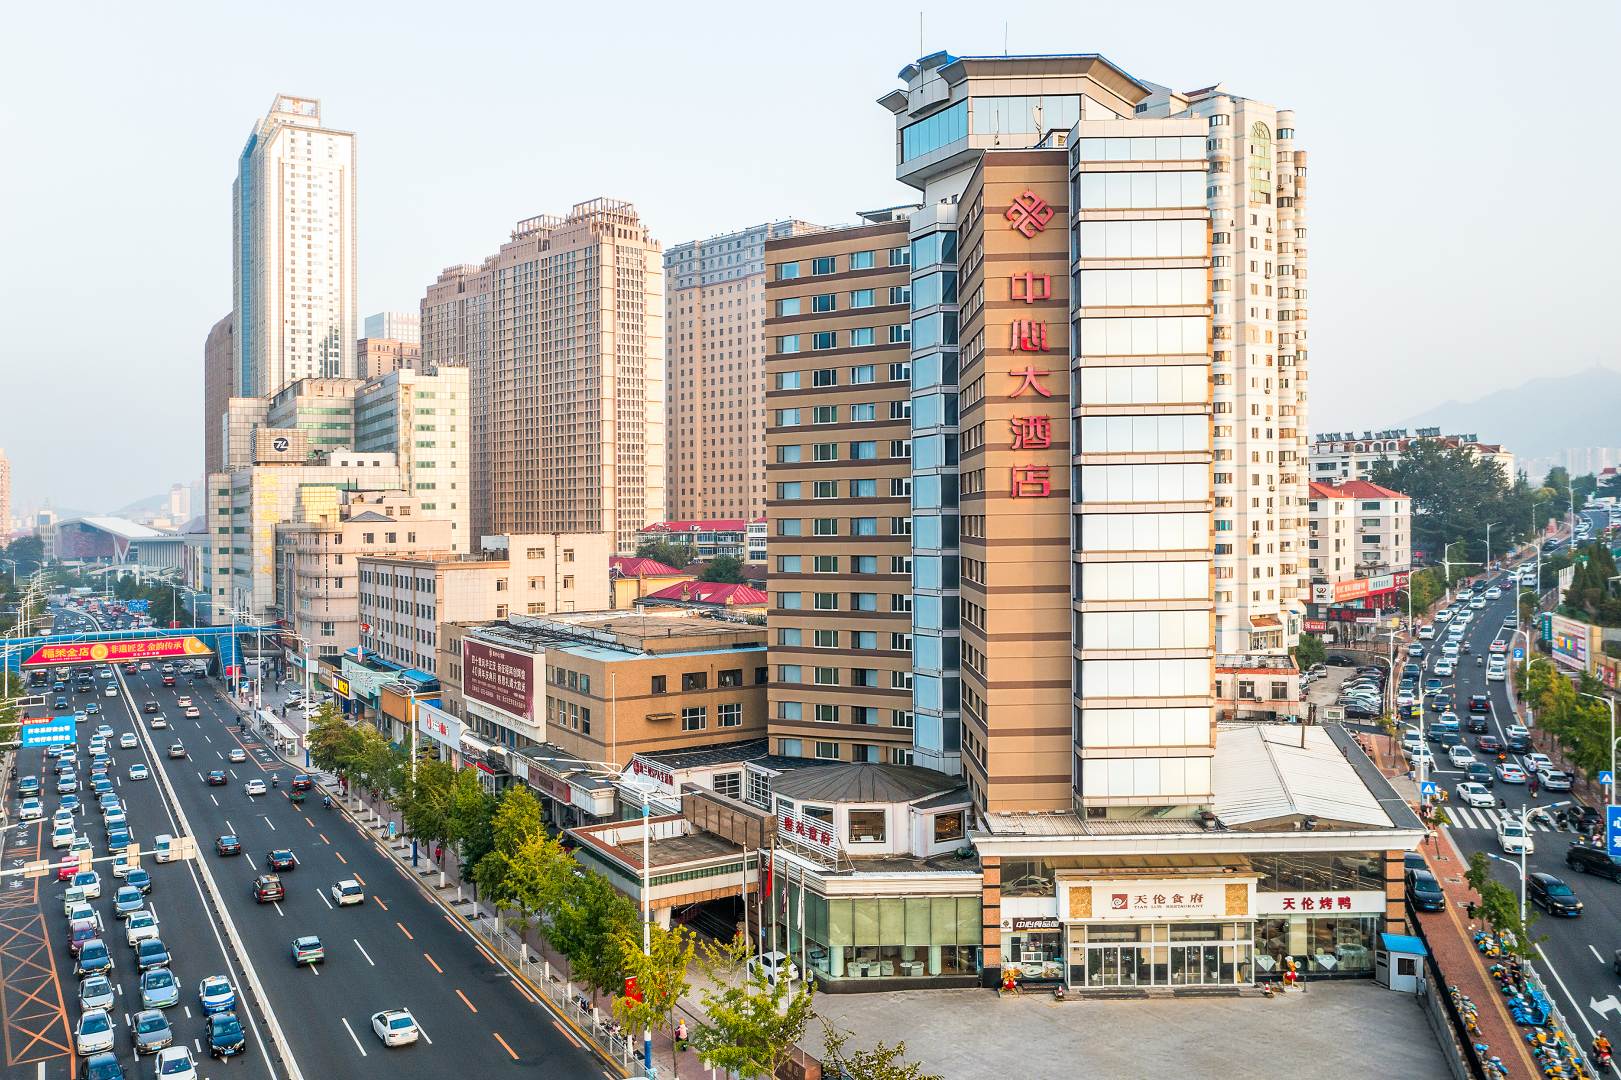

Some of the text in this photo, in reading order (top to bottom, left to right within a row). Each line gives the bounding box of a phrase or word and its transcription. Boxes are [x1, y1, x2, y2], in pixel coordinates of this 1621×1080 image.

[1009, 270, 1053, 500] 中心大酒店
[1133, 893, 1204, 904] 天伦食府
[1282, 896, 1352, 911] 天伦烤鸭
